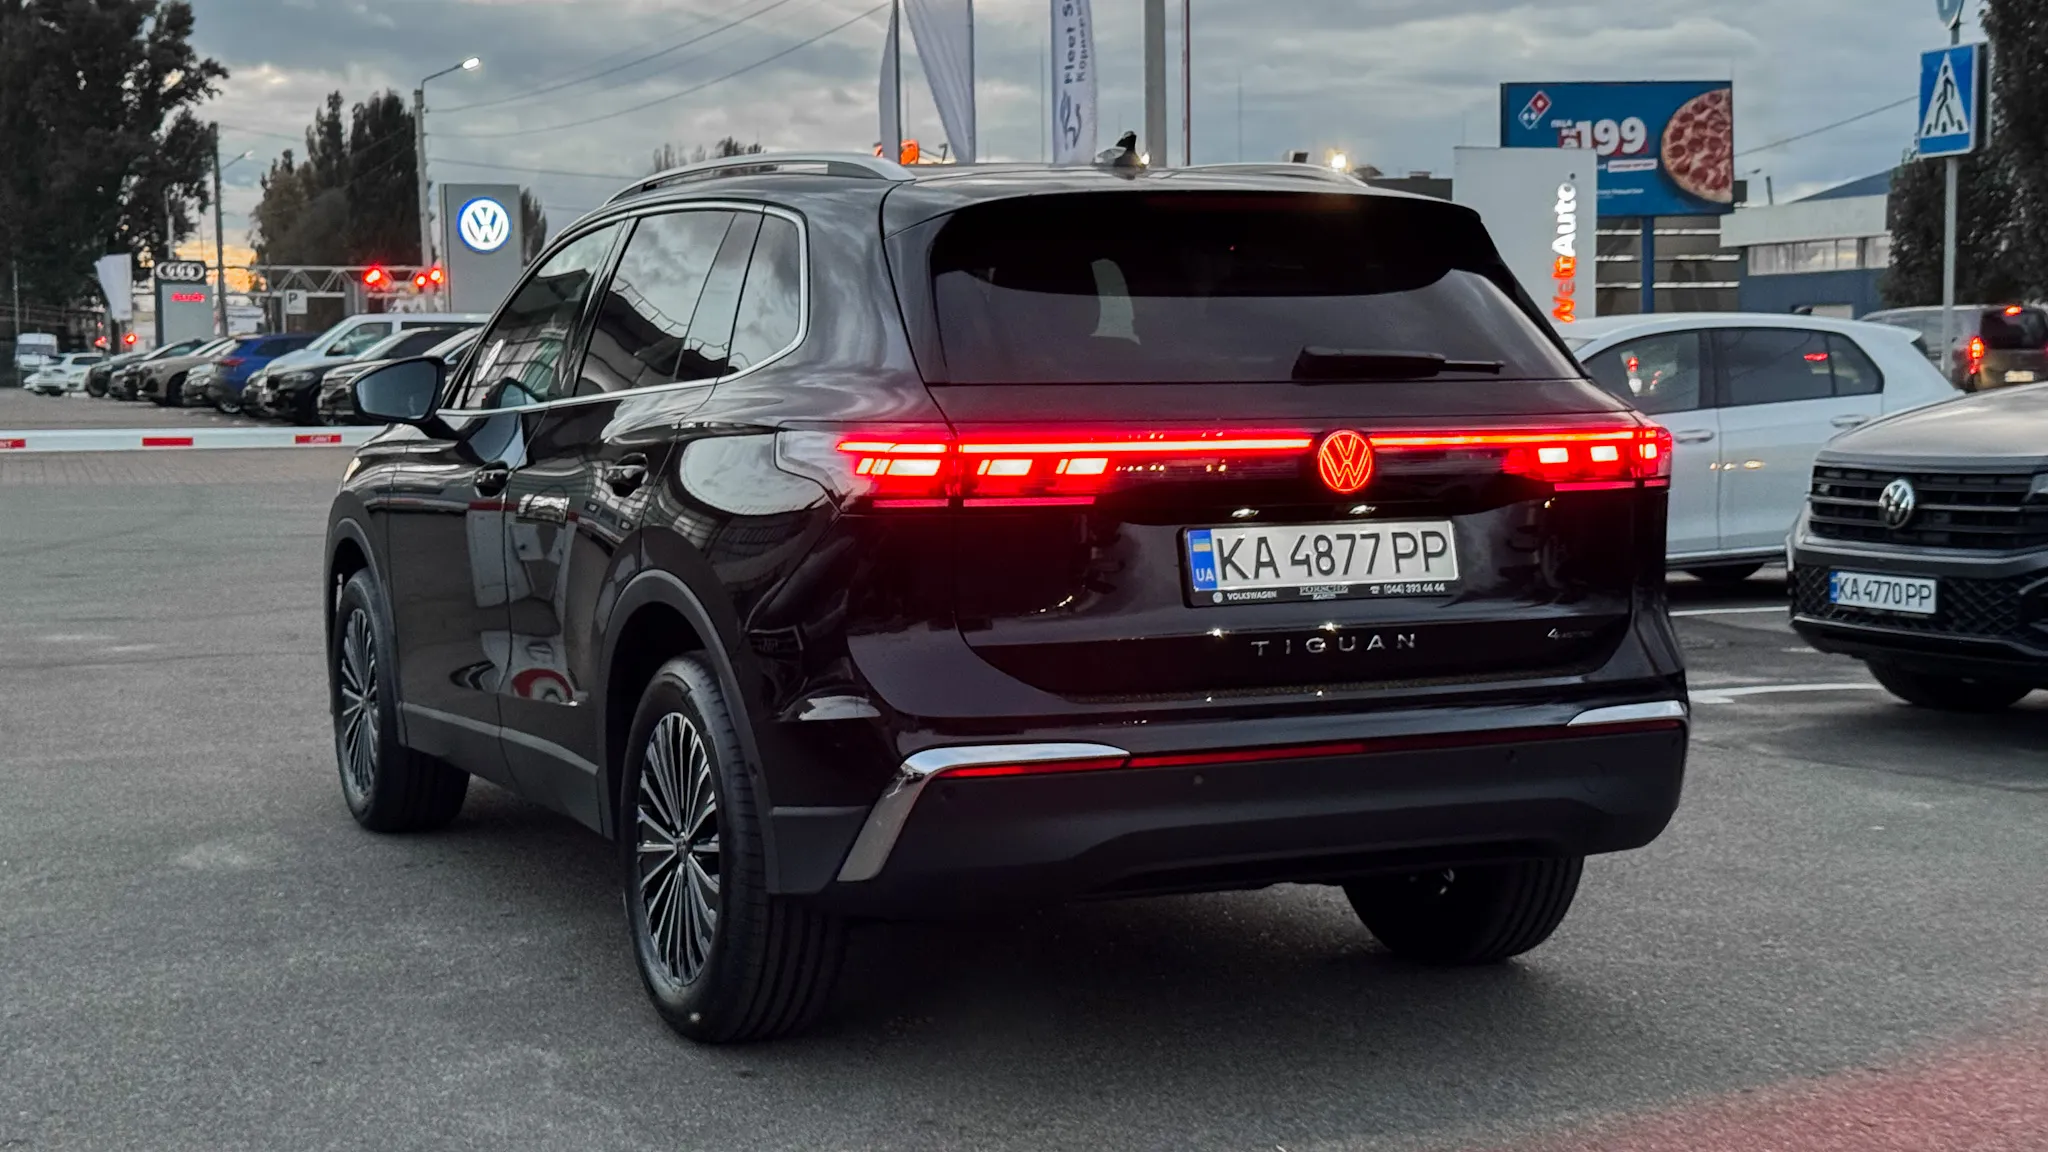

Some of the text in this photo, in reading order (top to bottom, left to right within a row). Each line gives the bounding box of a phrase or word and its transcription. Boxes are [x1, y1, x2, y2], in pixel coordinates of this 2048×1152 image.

[1062, 0, 1075, 84] Fleet S
[1576, 117, 1647, 156] 199
[288, 292, 298, 304] P
[1216, 531, 1447, 581] KA 4877 PP
[1195, 568, 1215, 582] UA
[1226, 590, 1278, 600] VOLKSWAGEN
[1383, 582, 1446, 594] (044) 393 44 44
[1839, 577, 1932, 607] KA 4770 PP
[1250, 633, 1416, 657] TIGUAN
